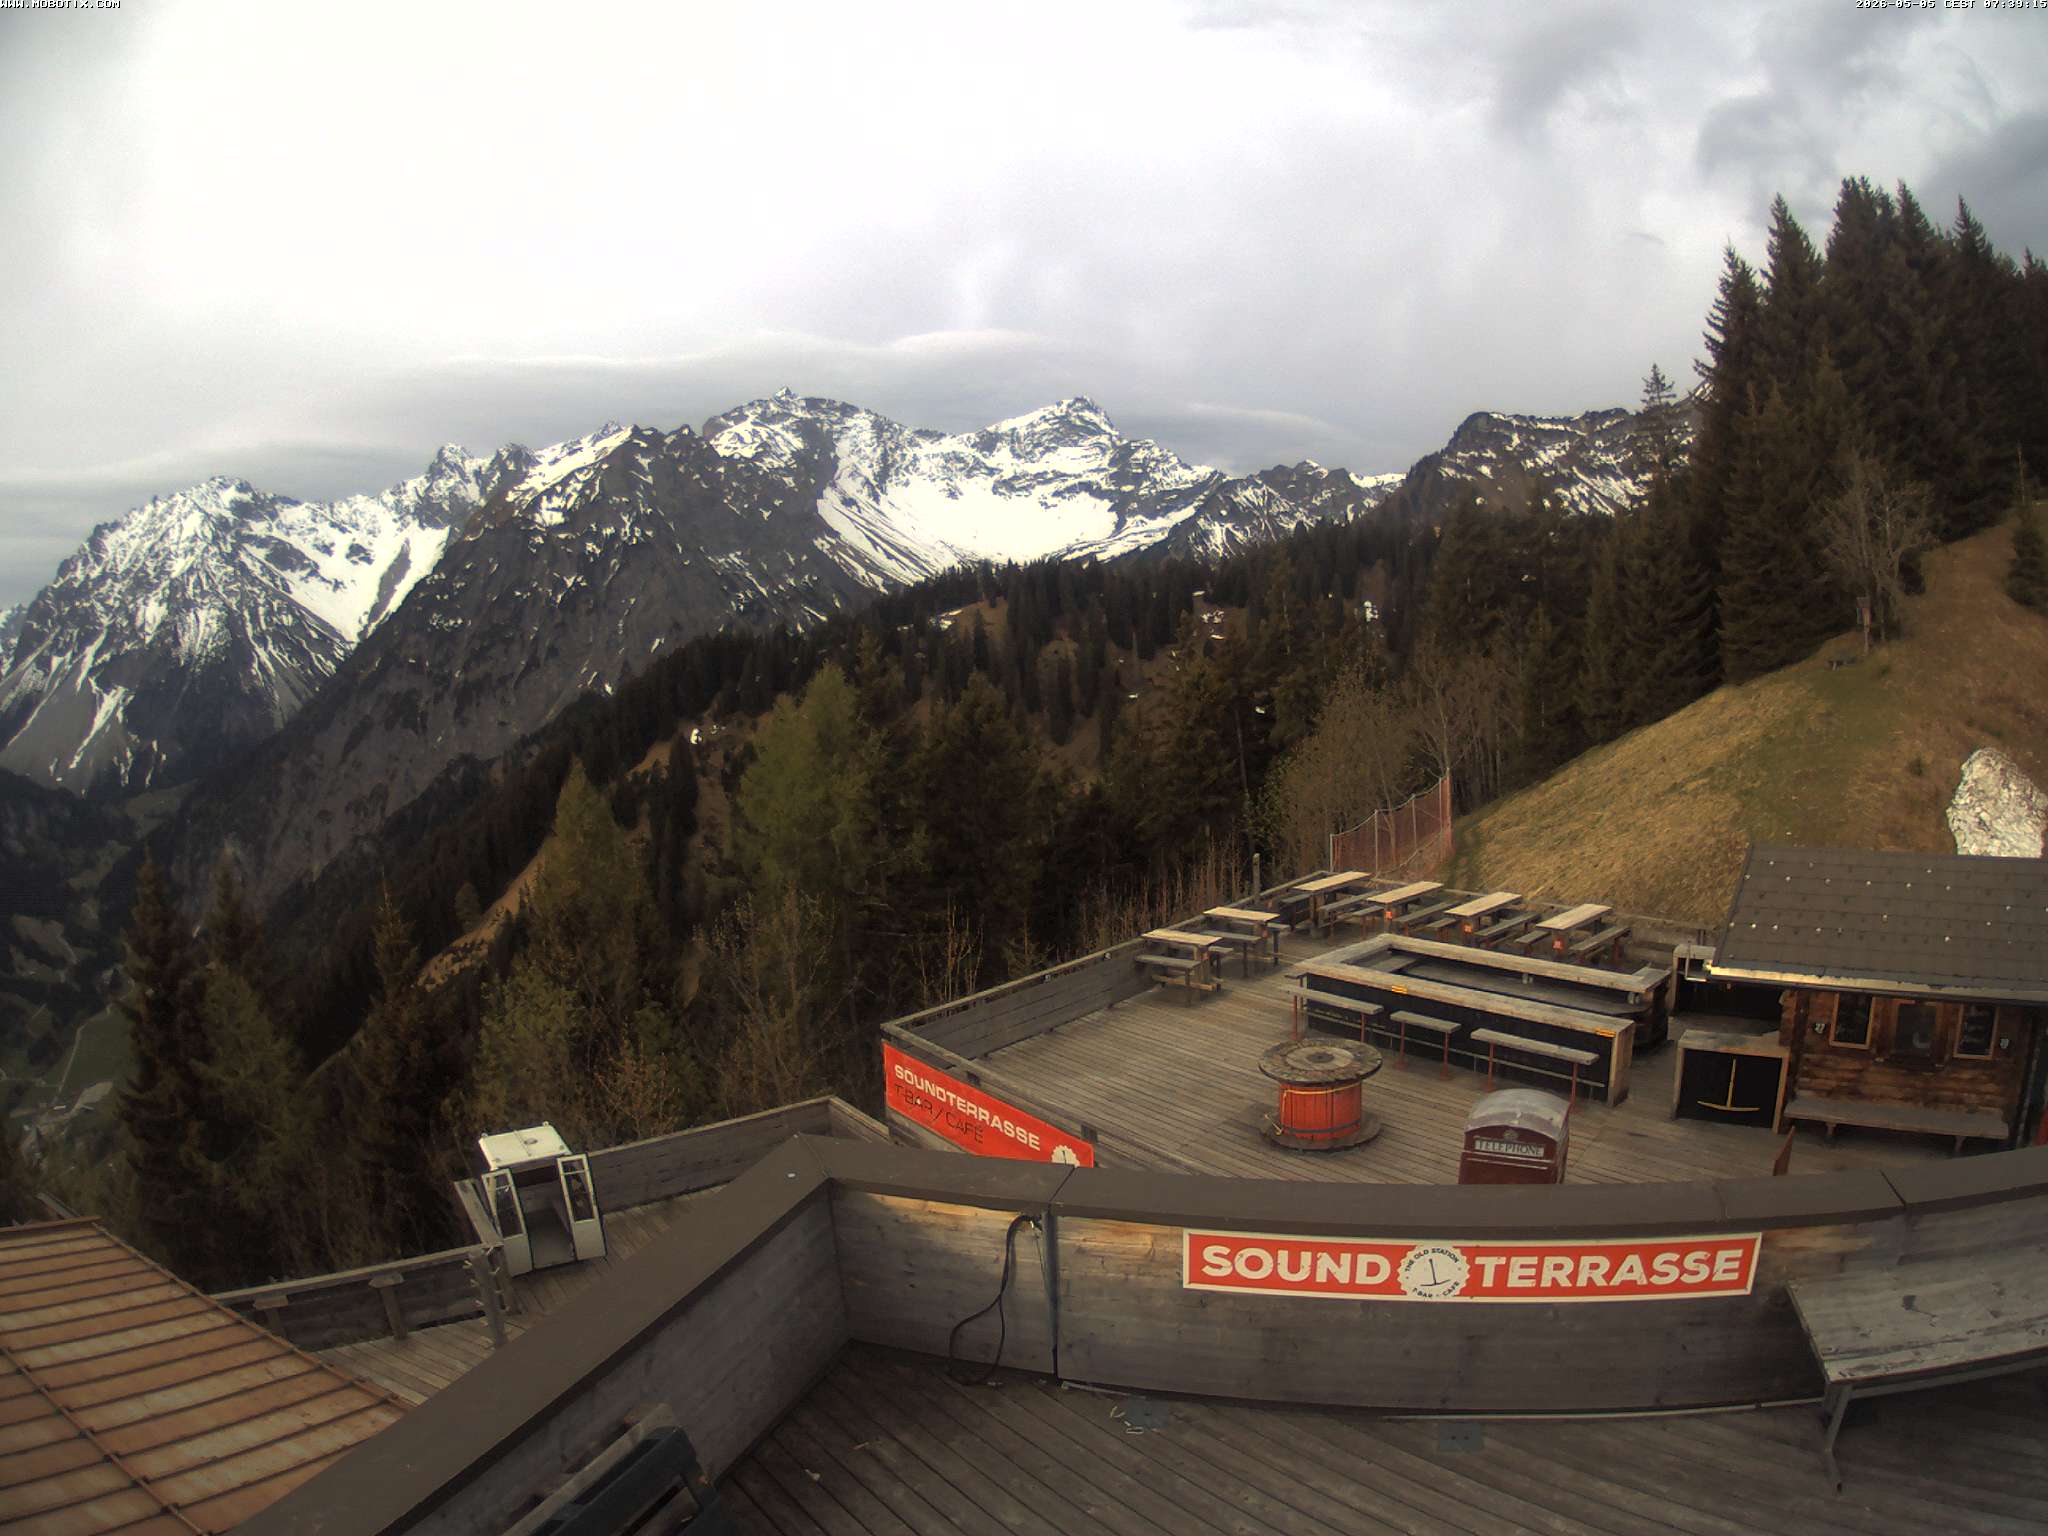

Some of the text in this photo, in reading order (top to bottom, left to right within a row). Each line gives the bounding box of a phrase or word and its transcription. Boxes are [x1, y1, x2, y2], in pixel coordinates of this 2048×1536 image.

[894, 1064, 1041, 1151] SOUNDTERRASSE
[1476, 1141, 1543, 1156] TELEPHONE
[1202, 1245, 1743, 1288] SOUND TERRASSE
[1404, 1248, 1459, 1272] THE OLD STATION
